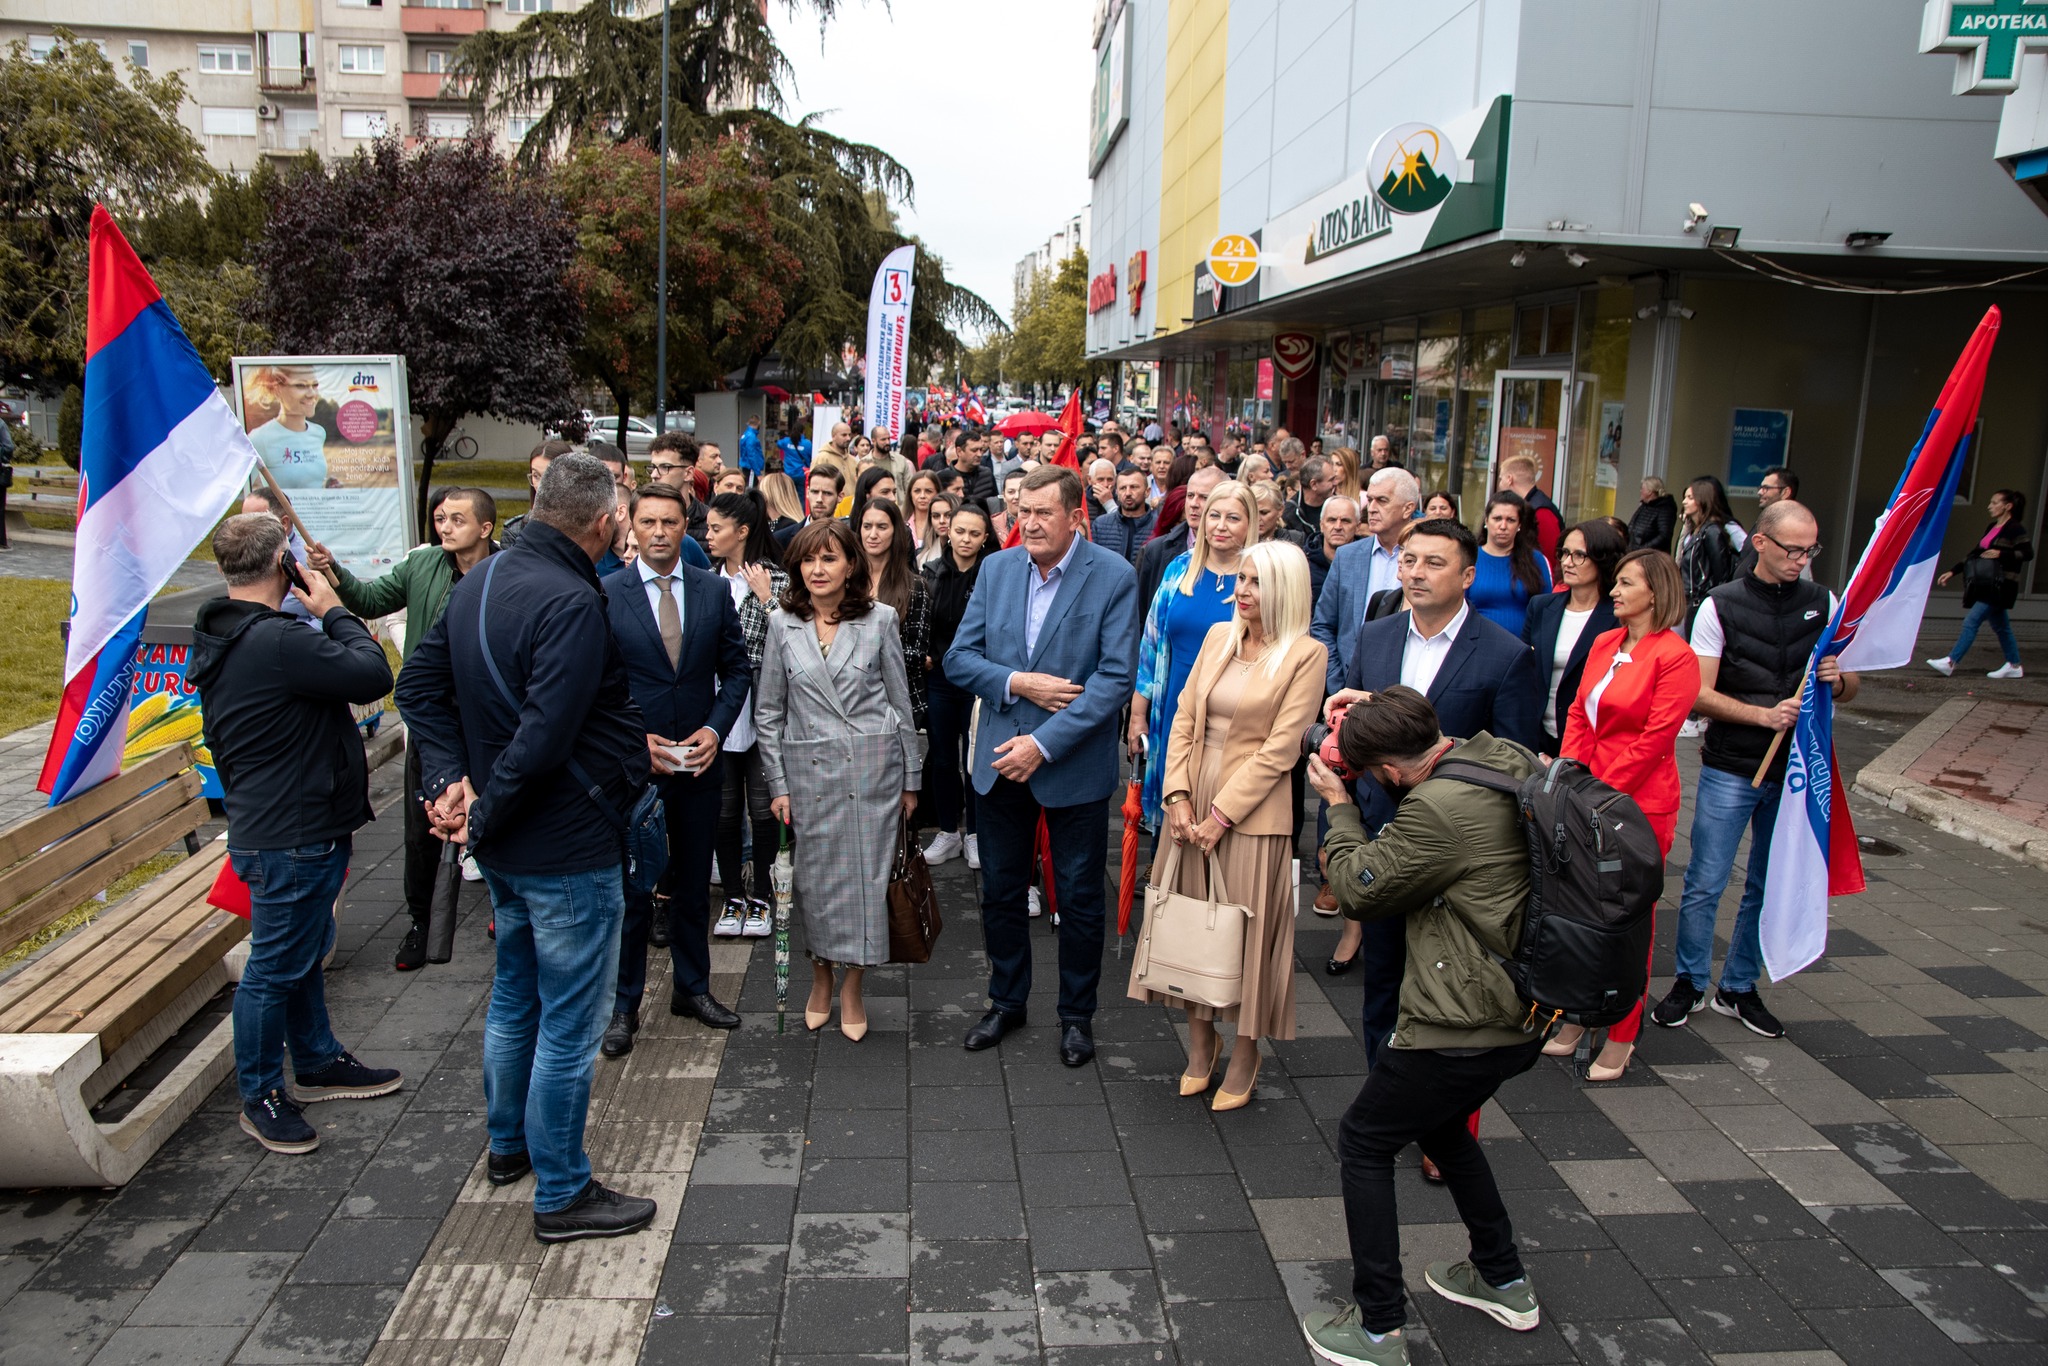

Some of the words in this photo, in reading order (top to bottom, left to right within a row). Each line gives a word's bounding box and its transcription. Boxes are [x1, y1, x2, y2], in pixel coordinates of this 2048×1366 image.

[1960, 14, 2047, 30] APOTEKA
[1318, 204, 1349, 253] ATOS
[1222, 239, 1246, 257] 24
[1227, 262, 1240, 280] 7
[890, 272, 902, 302] 3
[892, 315, 905, 386] СТАНИШИЋ
[352, 371, 375, 385] dm
[890, 393, 902, 441] МИЛОШ
[373, 455, 390, 463] kada
